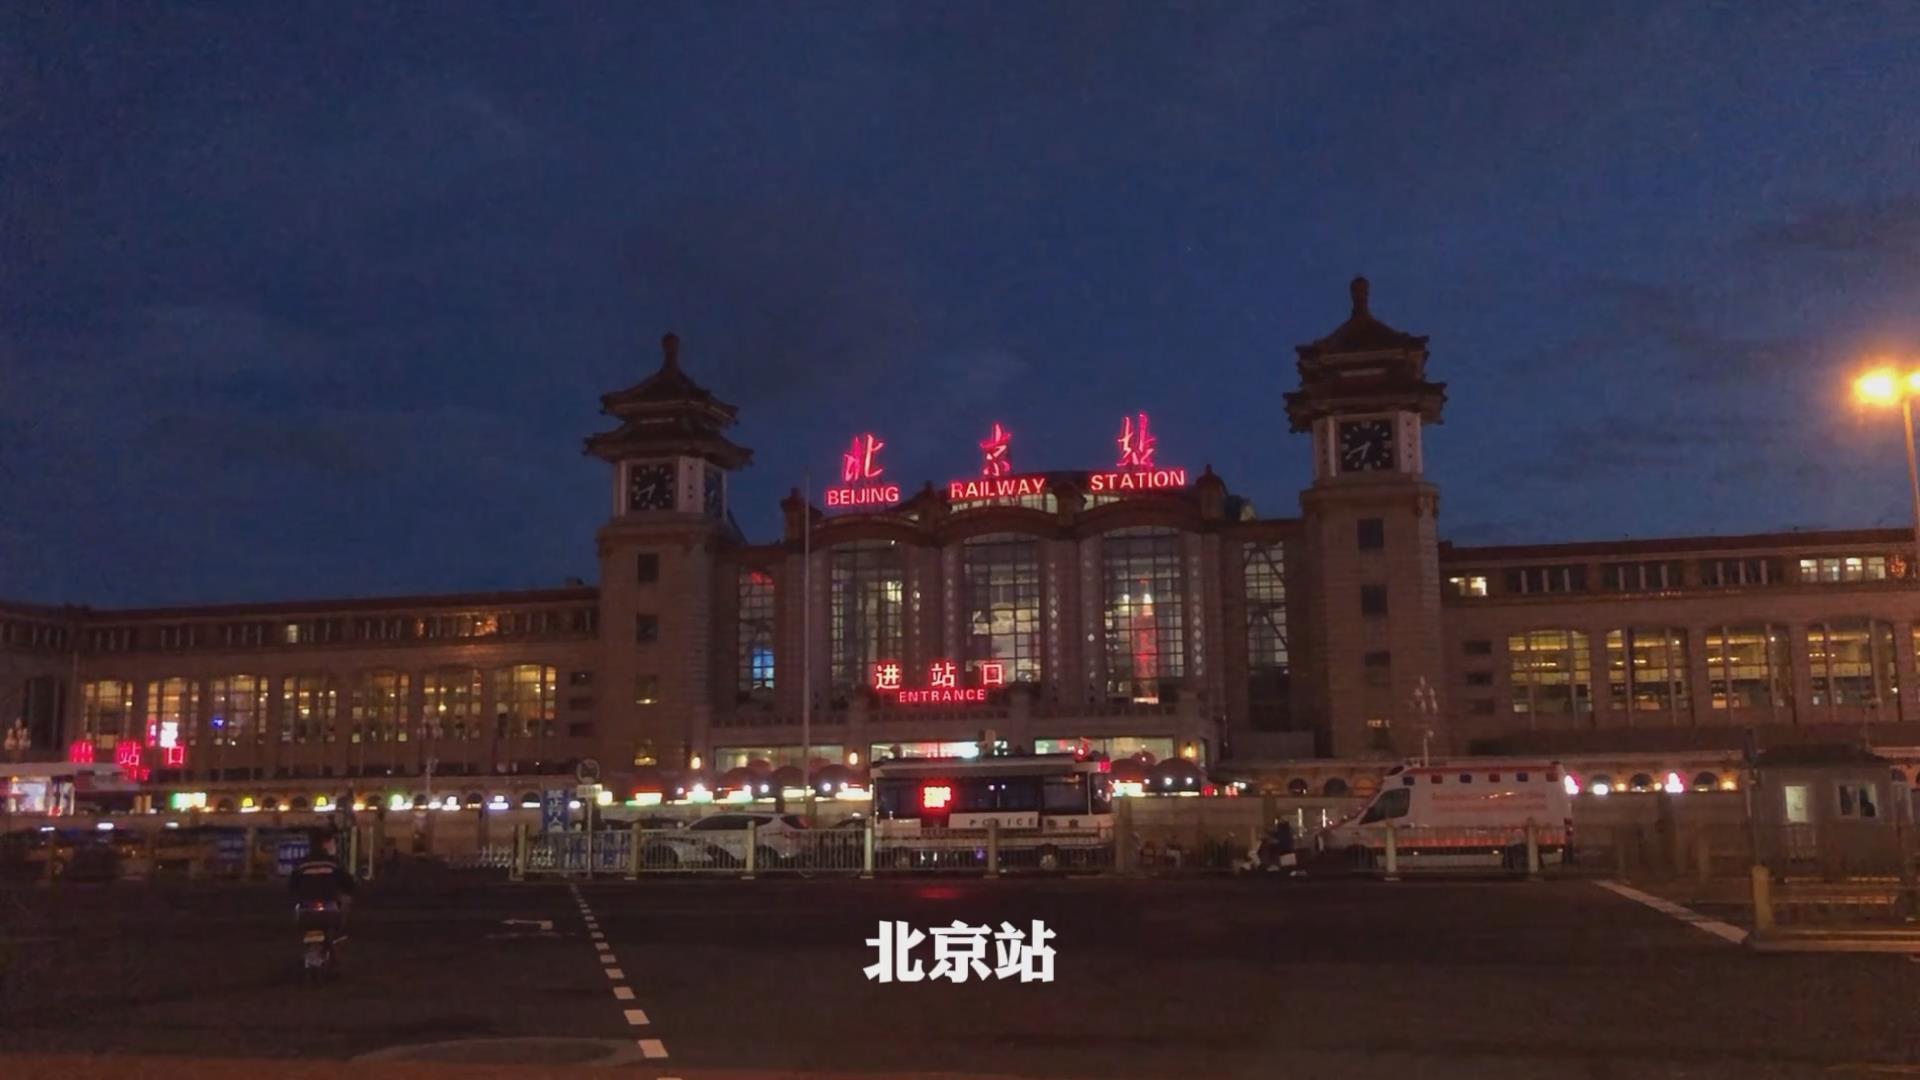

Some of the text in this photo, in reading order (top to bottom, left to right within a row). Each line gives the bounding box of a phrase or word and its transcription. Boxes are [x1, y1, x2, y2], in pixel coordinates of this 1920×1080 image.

[828, 470, 1185, 506] BEIJING RAILWAY STATION
[875, 662, 1003, 690] 进站口
[899, 689, 985, 703] ENTRANCE
